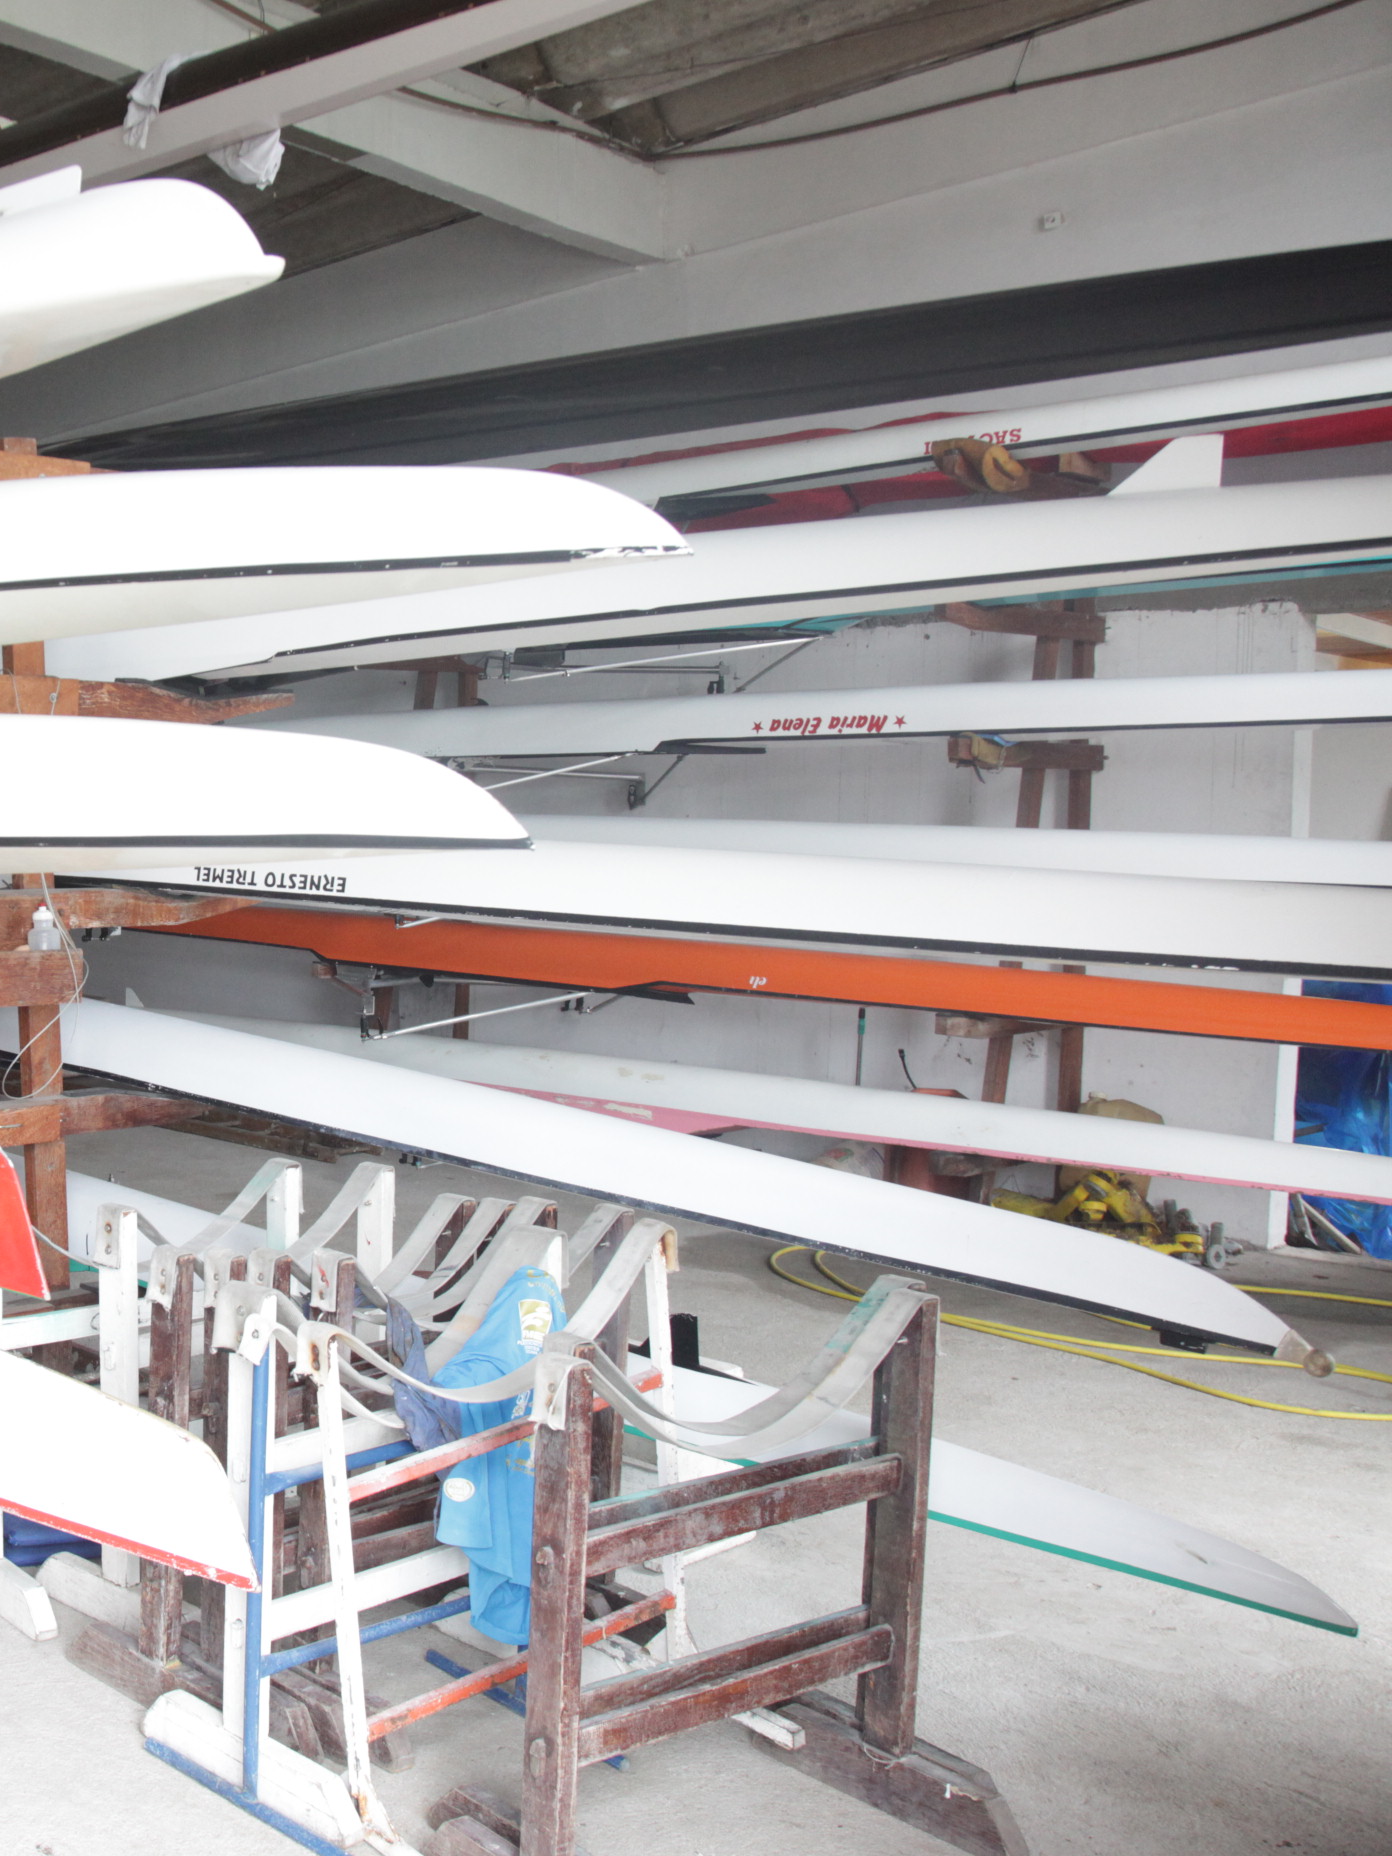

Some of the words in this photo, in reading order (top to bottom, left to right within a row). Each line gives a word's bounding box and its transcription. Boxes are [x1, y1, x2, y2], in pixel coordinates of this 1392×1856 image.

[769, 716, 822, 736] Elena
[828, 714, 888, 734] Maria
[194, 866, 257, 886] TREMEL
[264, 871, 347, 893] ERNESTO
